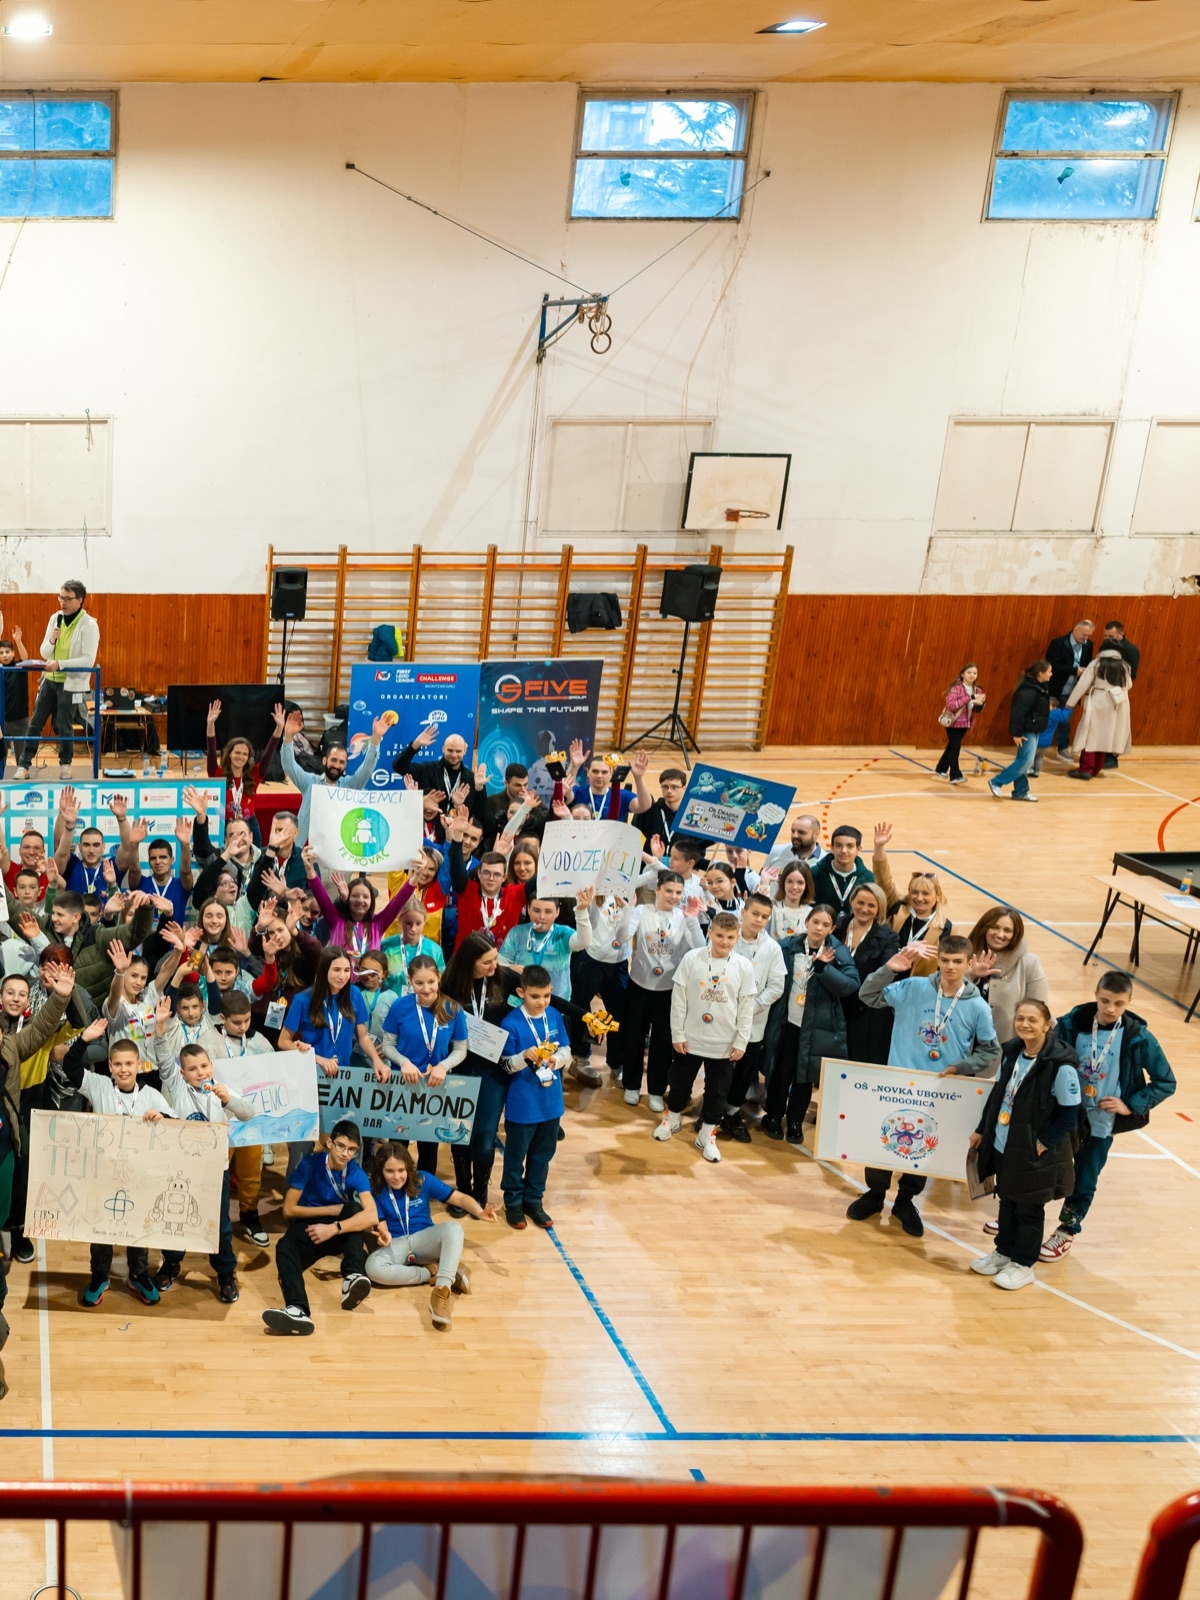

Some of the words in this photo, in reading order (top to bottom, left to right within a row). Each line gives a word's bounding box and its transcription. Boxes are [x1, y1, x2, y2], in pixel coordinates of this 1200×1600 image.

[550, 705, 589, 713] FUTURE
[327, 787, 403, 804] VODOZEMCI
[338, 846, 390, 867] PETROVAC
[854, 1082, 868, 1090] OŠ
[871, 1085, 913, 1096] „NOVKA
[317, 1083, 363, 1109] EAN
[370, 1088, 475, 1119] DIAMOND
[879, 1095, 935, 1108] PODGORICA
[363, 1117, 383, 1129] BAR
[48, 1113, 170, 1151] CYBER
[44, 1145, 100, 1180] TEN
[33, 1209, 60, 1220] FIRST
[33, 1219, 57, 1229] LEGO
